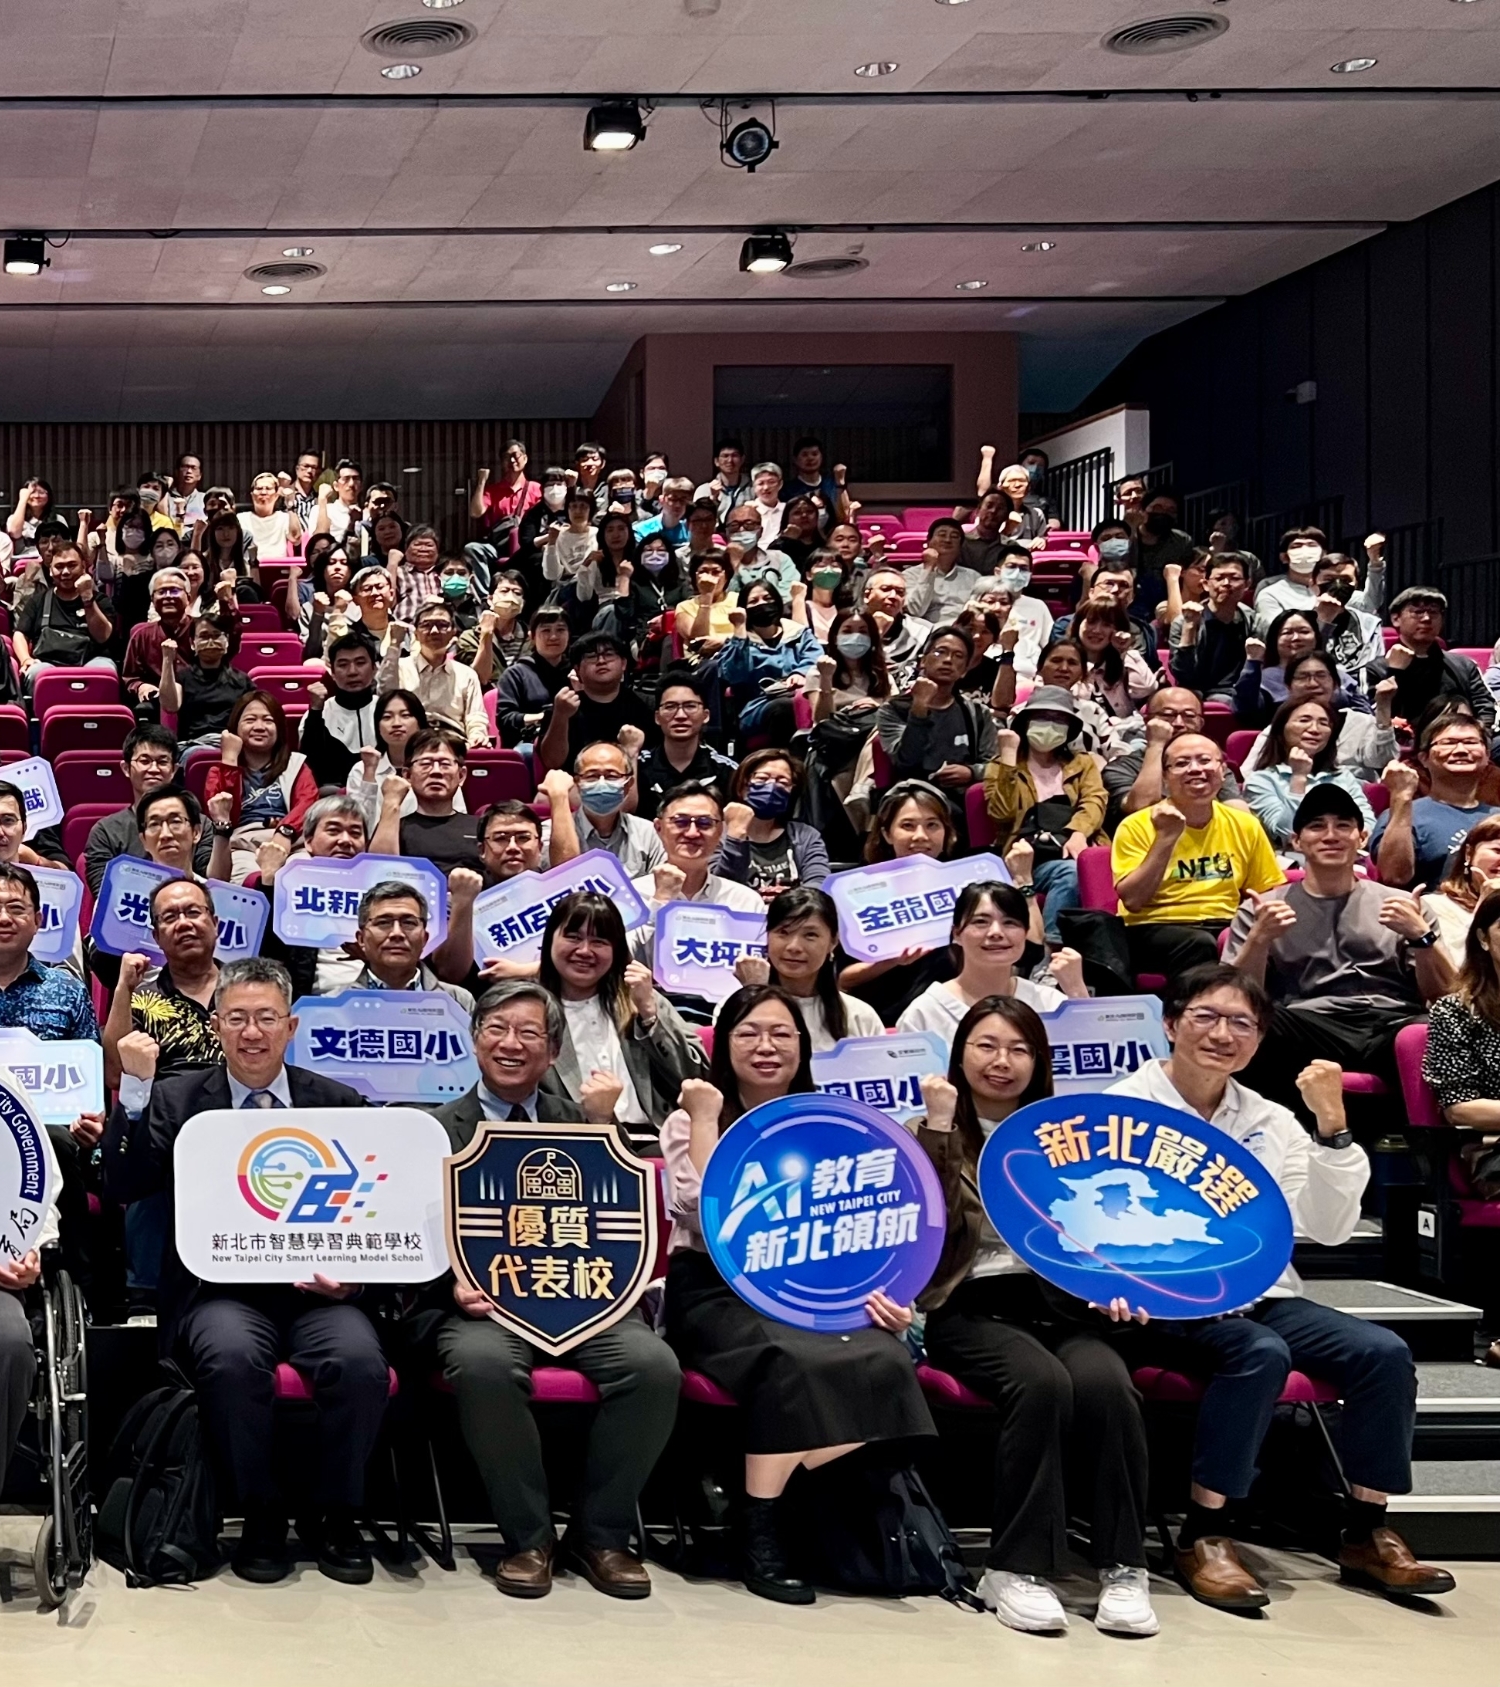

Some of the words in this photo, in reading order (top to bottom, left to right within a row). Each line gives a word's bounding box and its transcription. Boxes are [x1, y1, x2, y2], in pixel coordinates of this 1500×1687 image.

[311, 1026, 463, 1061] 文德國小
[11, 1113, 40, 1196] Government
[811, 1147, 898, 1200] 教育
[1033, 1114, 1260, 1219] 新北嚴選
[809, 1203, 836, 1218] NEW
[838, 1194, 874, 1211] TAIPEI
[876, 1189, 902, 1204] CITY
[211, 1232, 423, 1251] 新北市智慧學習典範學校
[507, 1204, 592, 1250] 優質
[743, 1202, 921, 1274] 新北領航
[212, 1254, 232, 1263] New
[235, 1253, 262, 1264] Taipei
[265, 1254, 283, 1264] City
[286, 1254, 314, 1263] Smart
[316, 1253, 357, 1264] Learning
[360, 1253, 389, 1263] Model
[391, 1253, 423, 1263] School
[488, 1254, 616, 1300] 代表校
